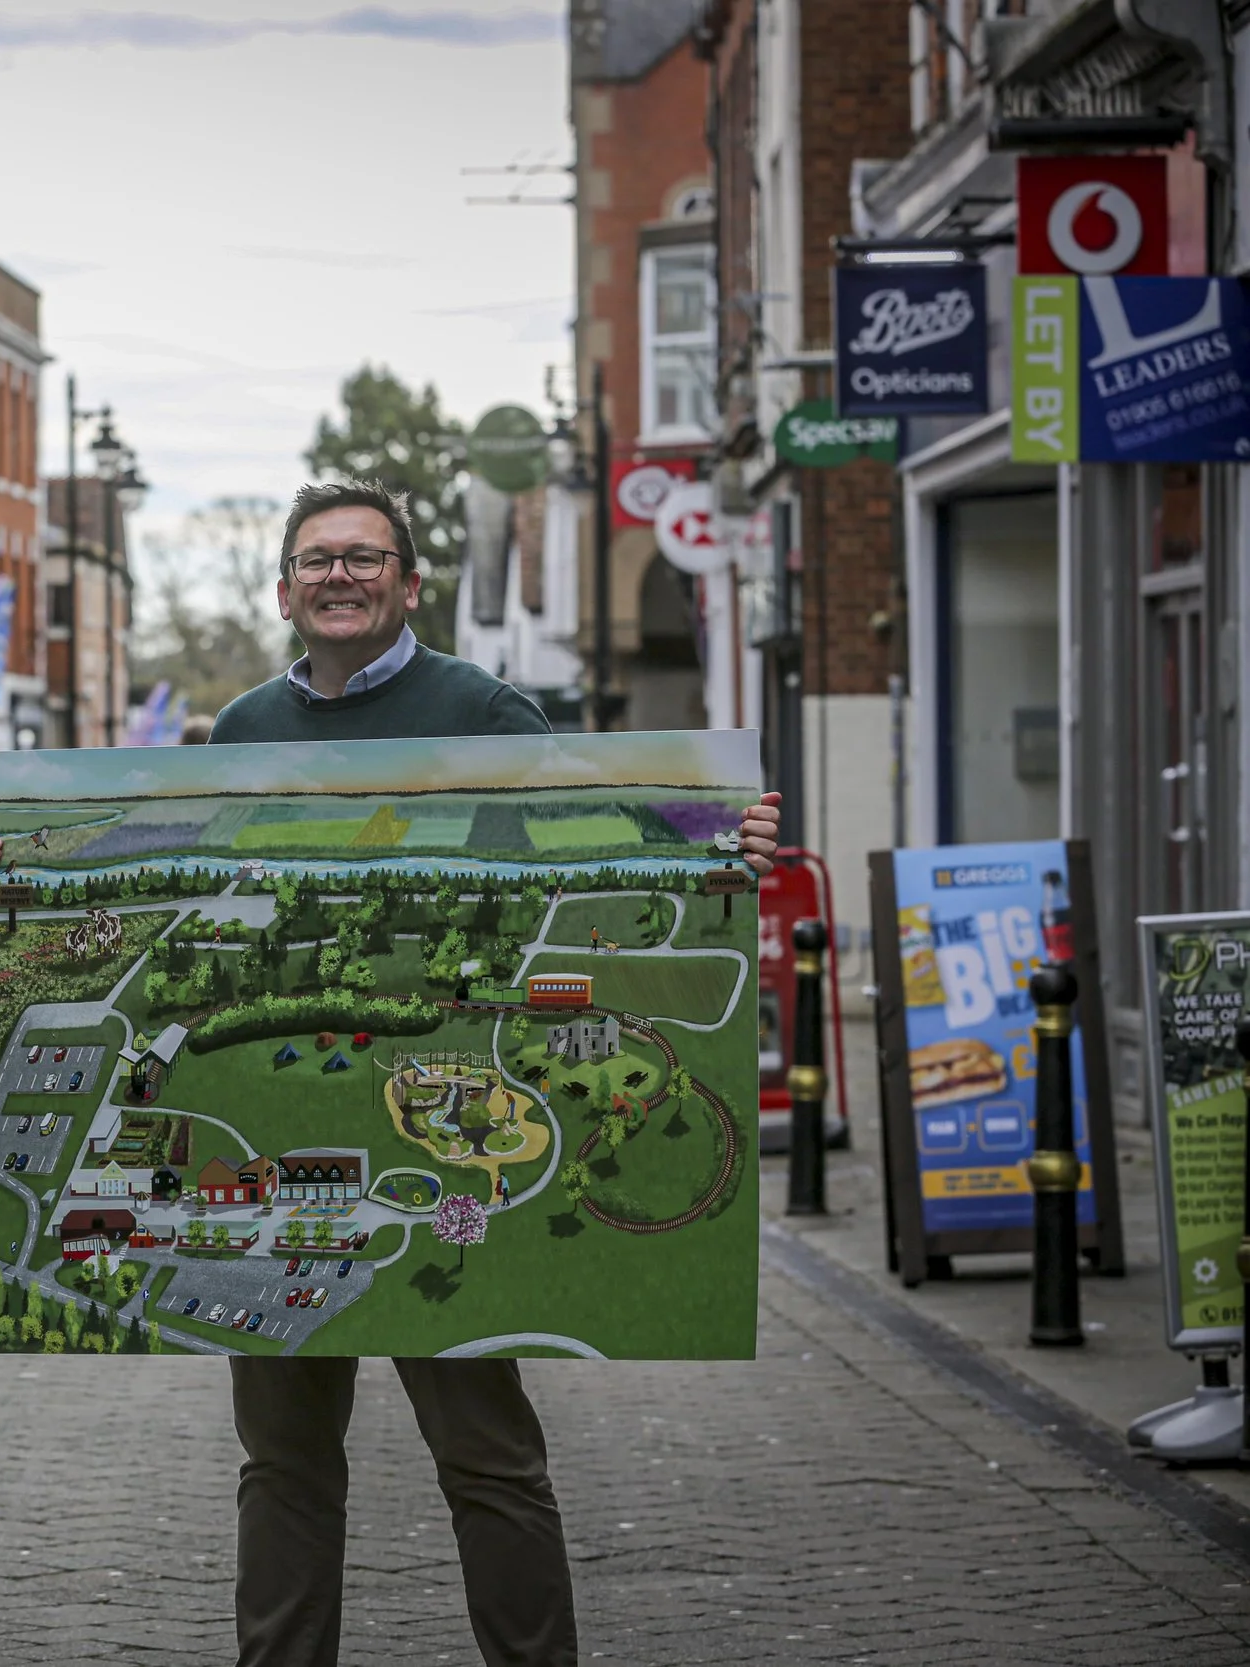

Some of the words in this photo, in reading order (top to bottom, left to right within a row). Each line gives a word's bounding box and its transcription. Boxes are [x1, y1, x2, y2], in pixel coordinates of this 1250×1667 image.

[849, 287, 975, 357] Boots
[1025, 286, 1064, 375] LET
[1094, 331, 1233, 398] LEADERS
[850, 366, 974, 400] Opticians
[1025, 388, 1064, 452] BY
[953, 866, 1028, 885] GREGGS
[932, 915, 978, 949] THE
[1174, 995, 1199, 1010] WE
[1205, 992, 1243, 1008] TAKE
[1174, 1011, 1215, 1026] CARE
[1220, 1008, 1240, 1023] OF
[1176, 1026, 1216, 1041] YOUR
[1172, 1083, 1213, 1108] SAME
[1215, 1072, 1244, 1094] DAY
[1175, 1115, 1193, 1130] We
[1196, 1114, 1218, 1129] Can
